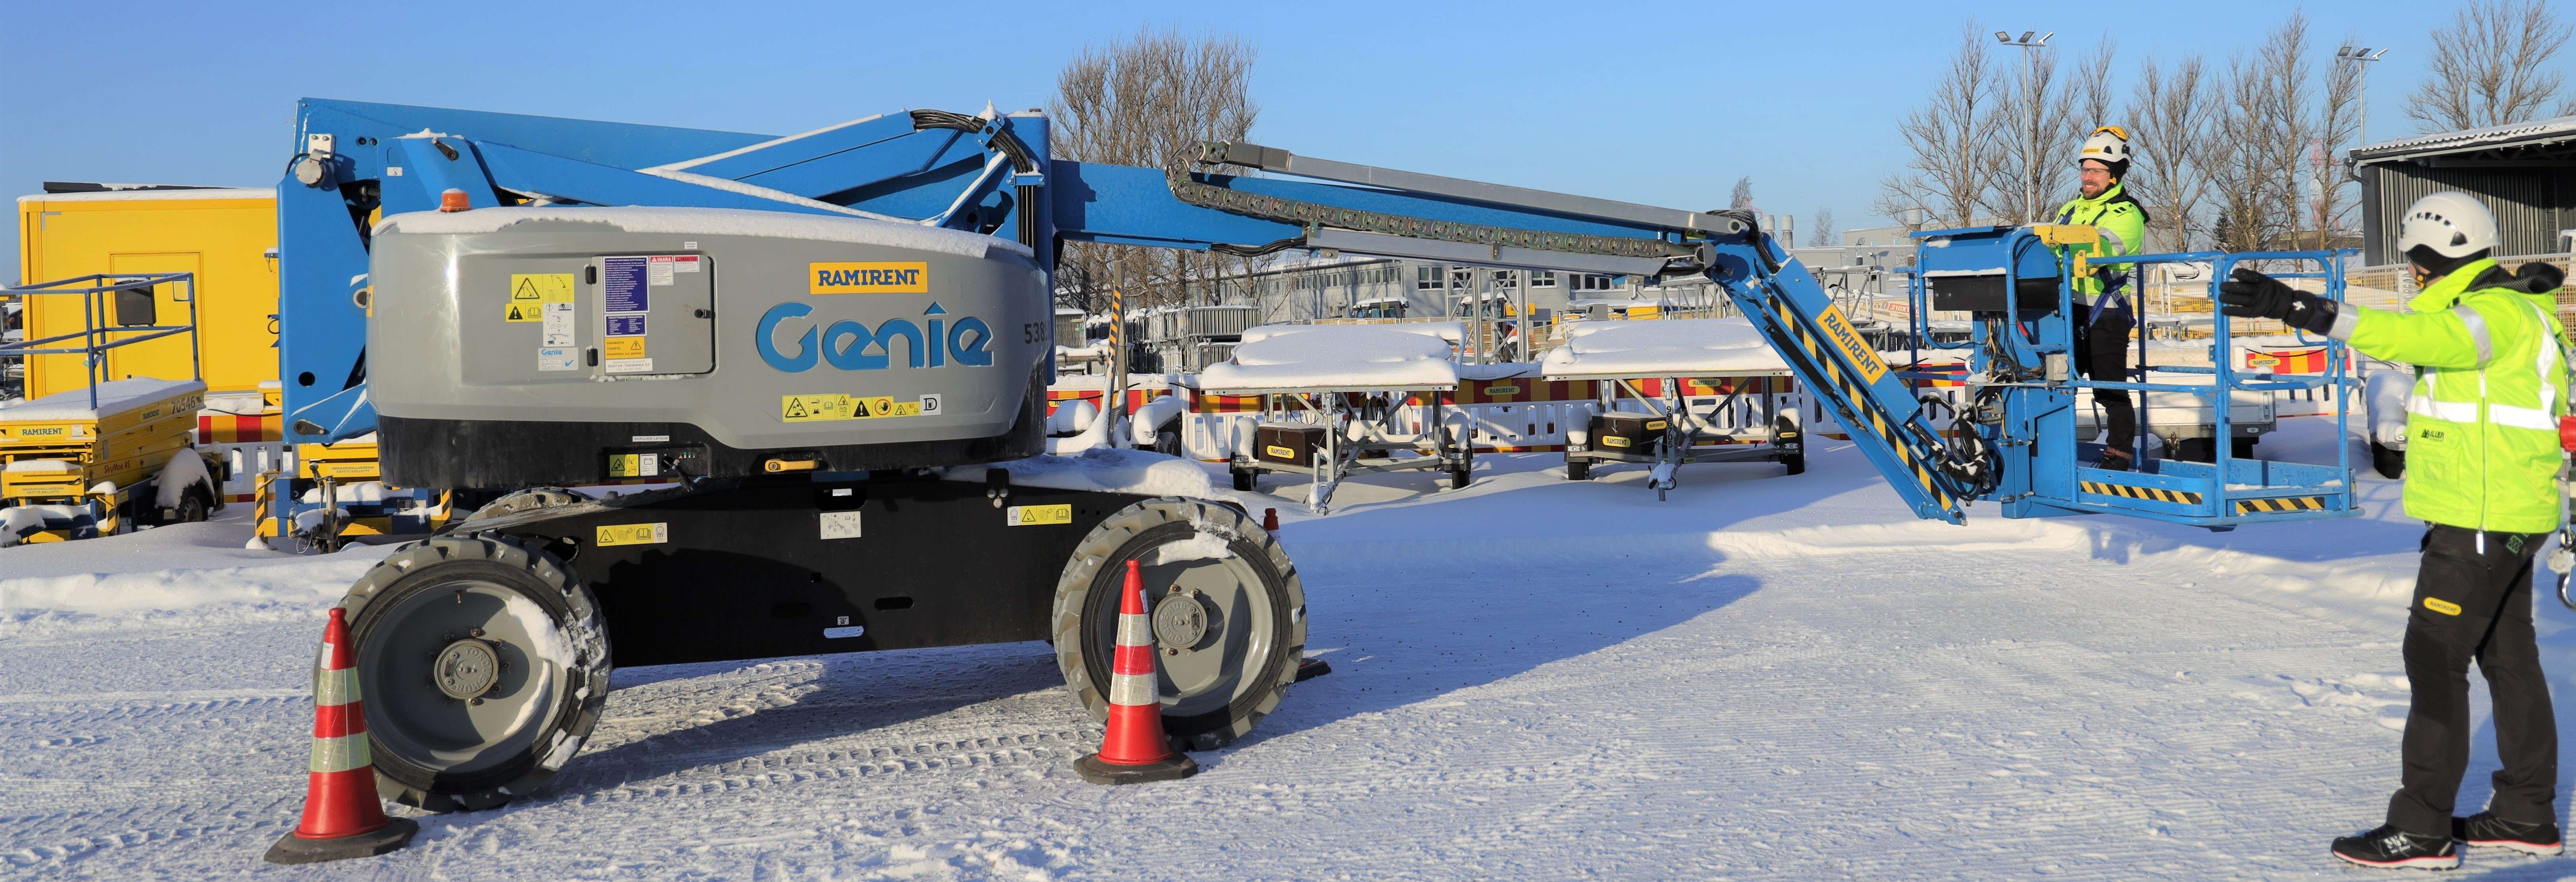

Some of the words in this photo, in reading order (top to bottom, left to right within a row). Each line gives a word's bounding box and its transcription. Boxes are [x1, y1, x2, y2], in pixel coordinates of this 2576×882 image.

[818, 269, 919, 286] RAMIRENT
[755, 301, 994, 373] Genie
[1824, 312, 1880, 375] RAMIRENT
